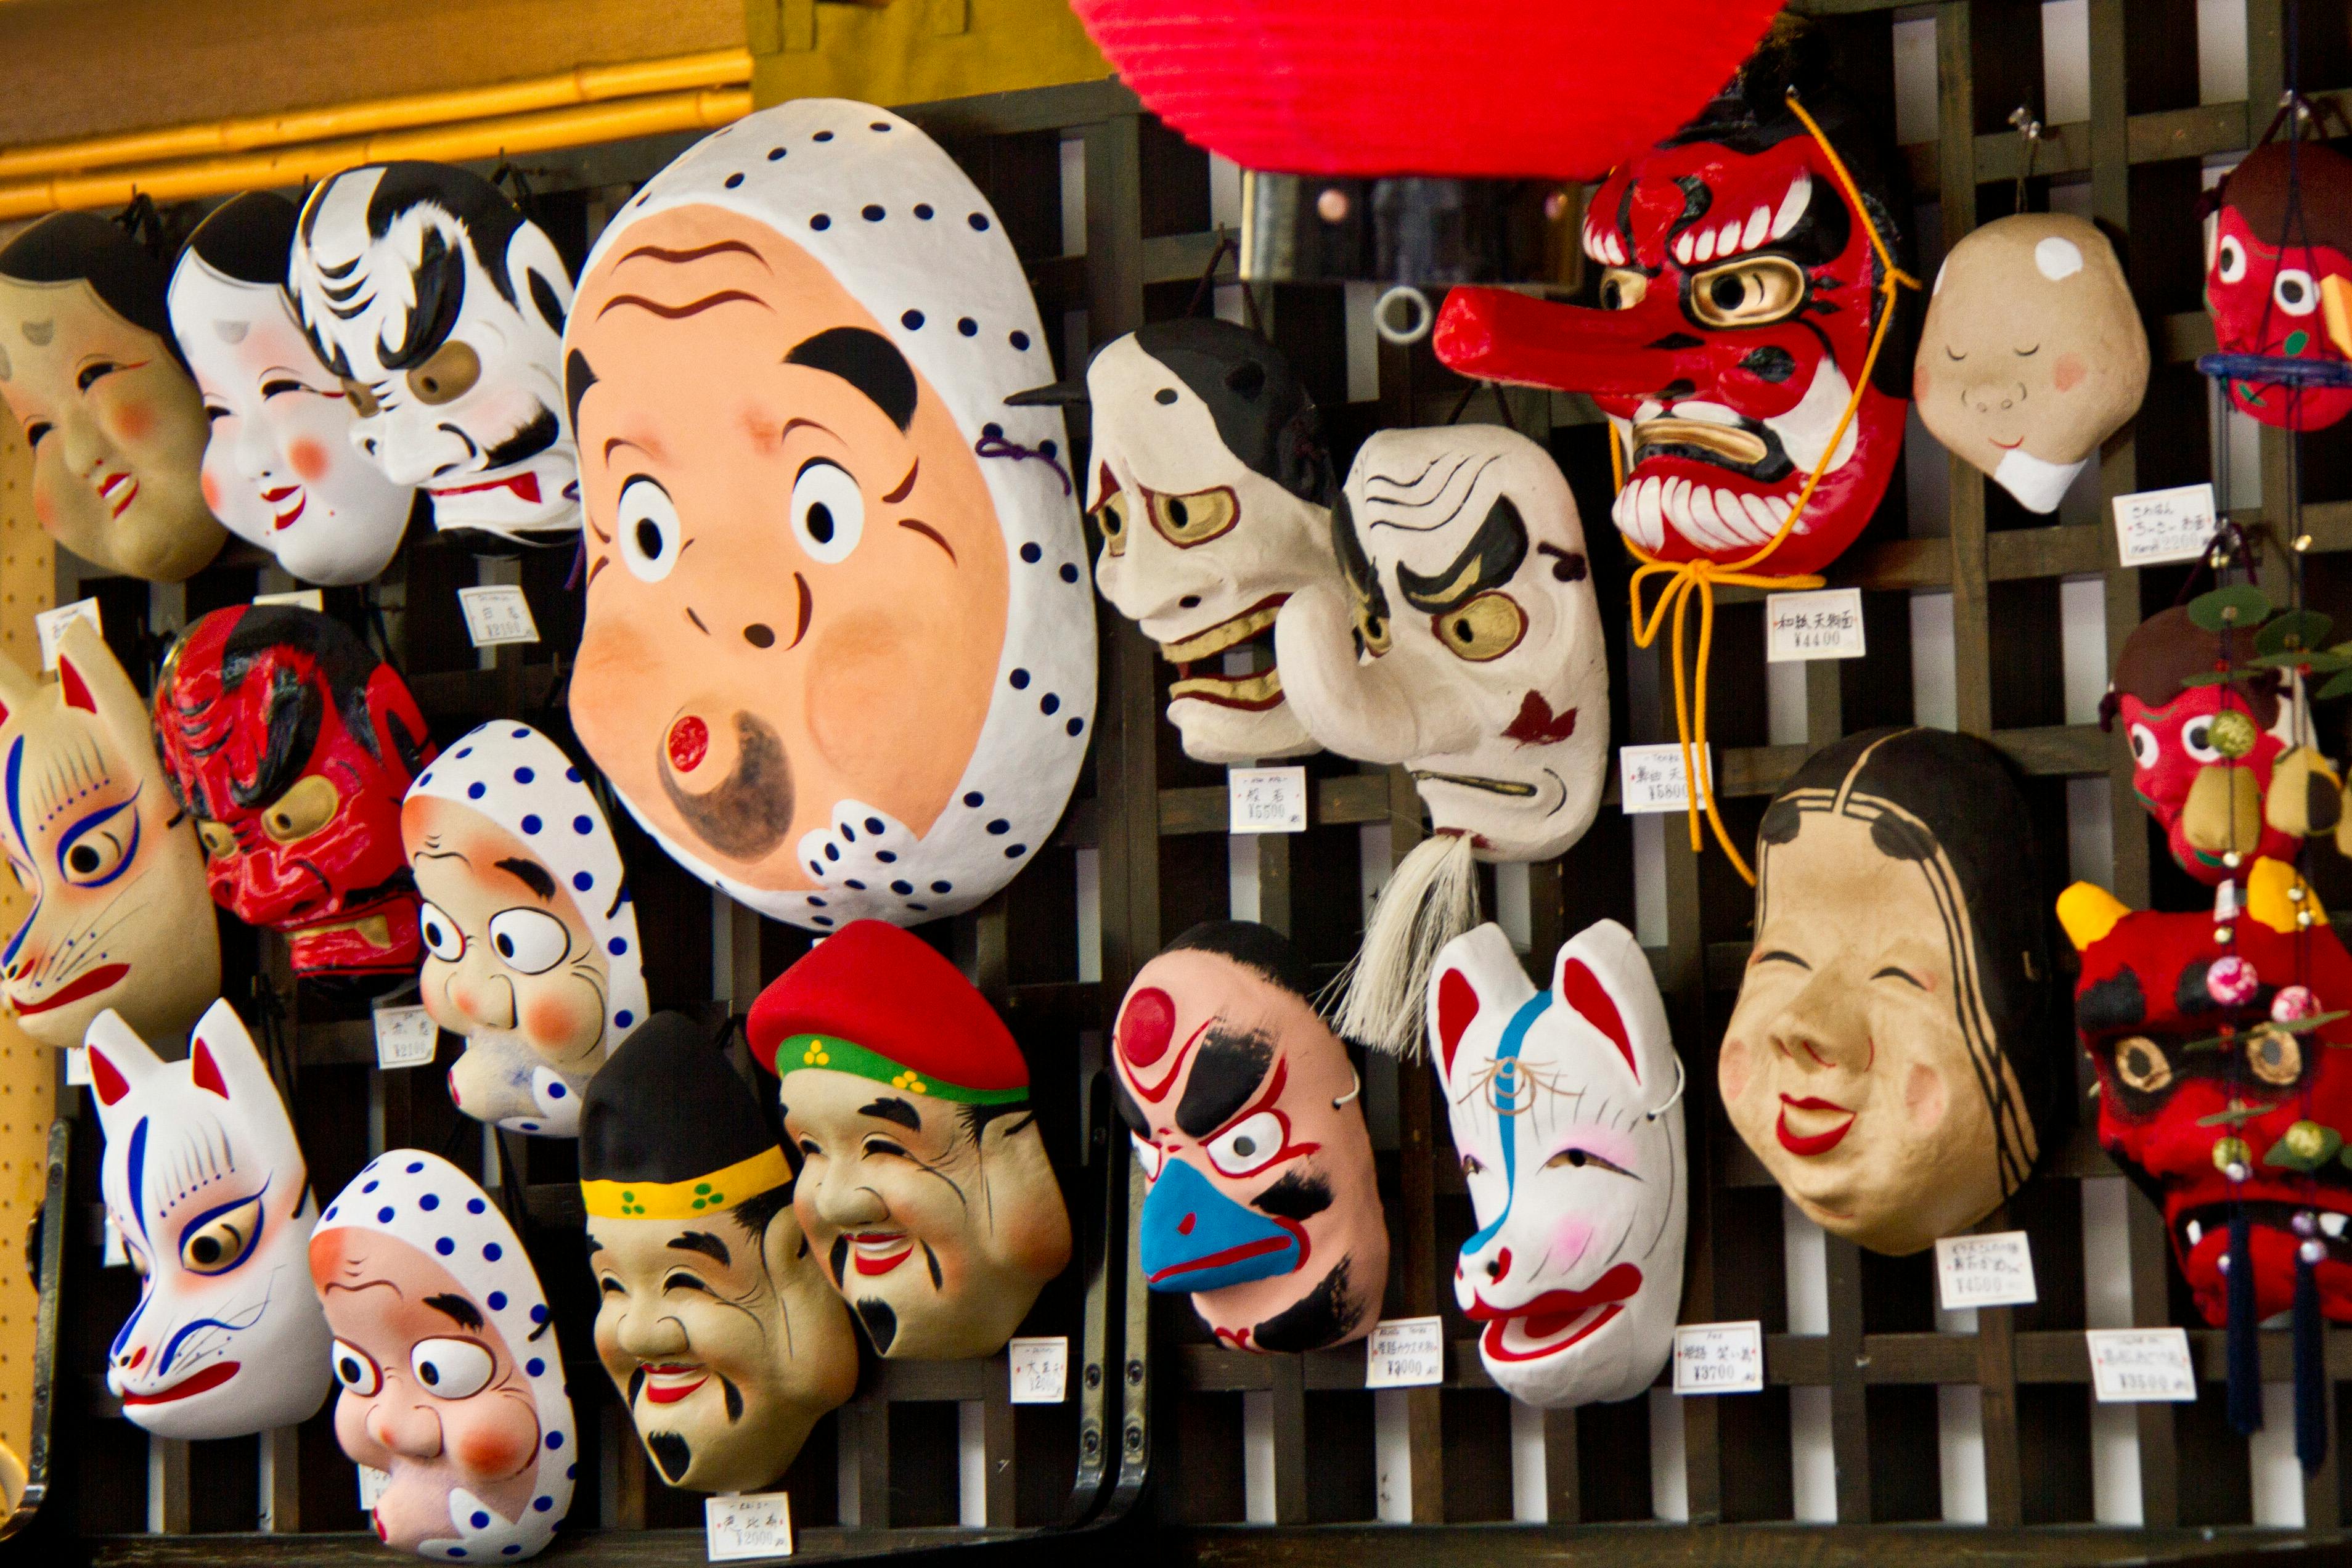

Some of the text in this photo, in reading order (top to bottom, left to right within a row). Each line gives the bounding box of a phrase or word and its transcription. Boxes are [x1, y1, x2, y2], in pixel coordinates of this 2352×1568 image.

[1794, 631, 1840, 648] ¥4400
[1247, 802, 1285, 820] ¥5500
[1693, 1363, 1735, 1382] ¥3700
